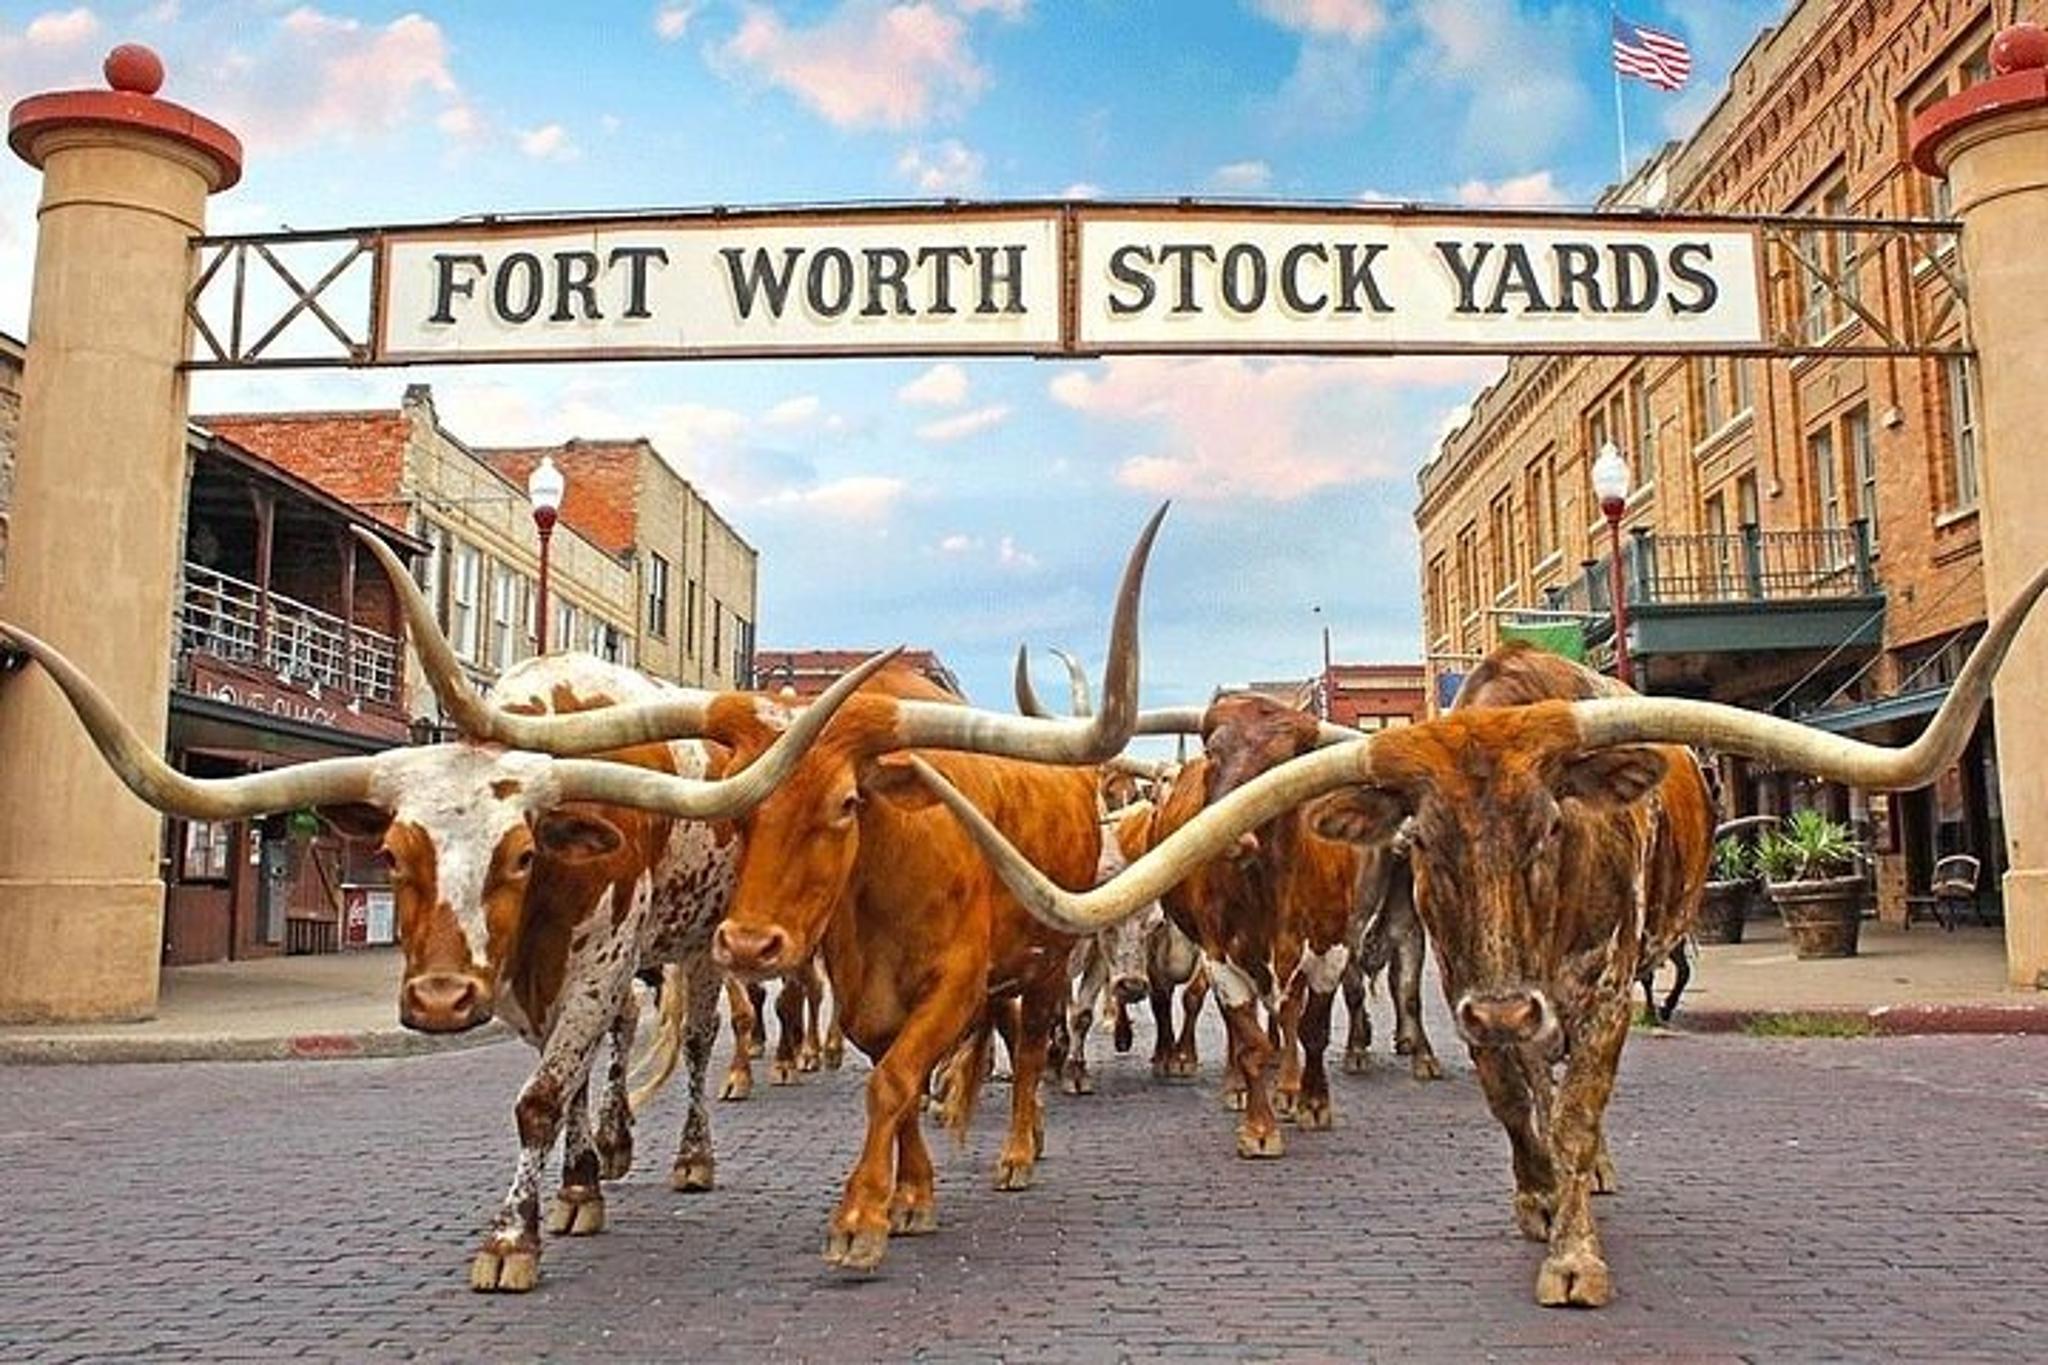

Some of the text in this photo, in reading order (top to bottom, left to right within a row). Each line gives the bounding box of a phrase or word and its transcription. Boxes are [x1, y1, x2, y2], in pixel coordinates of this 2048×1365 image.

[428, 241, 1718, 325] FORT WORTH STOCK YARDS
